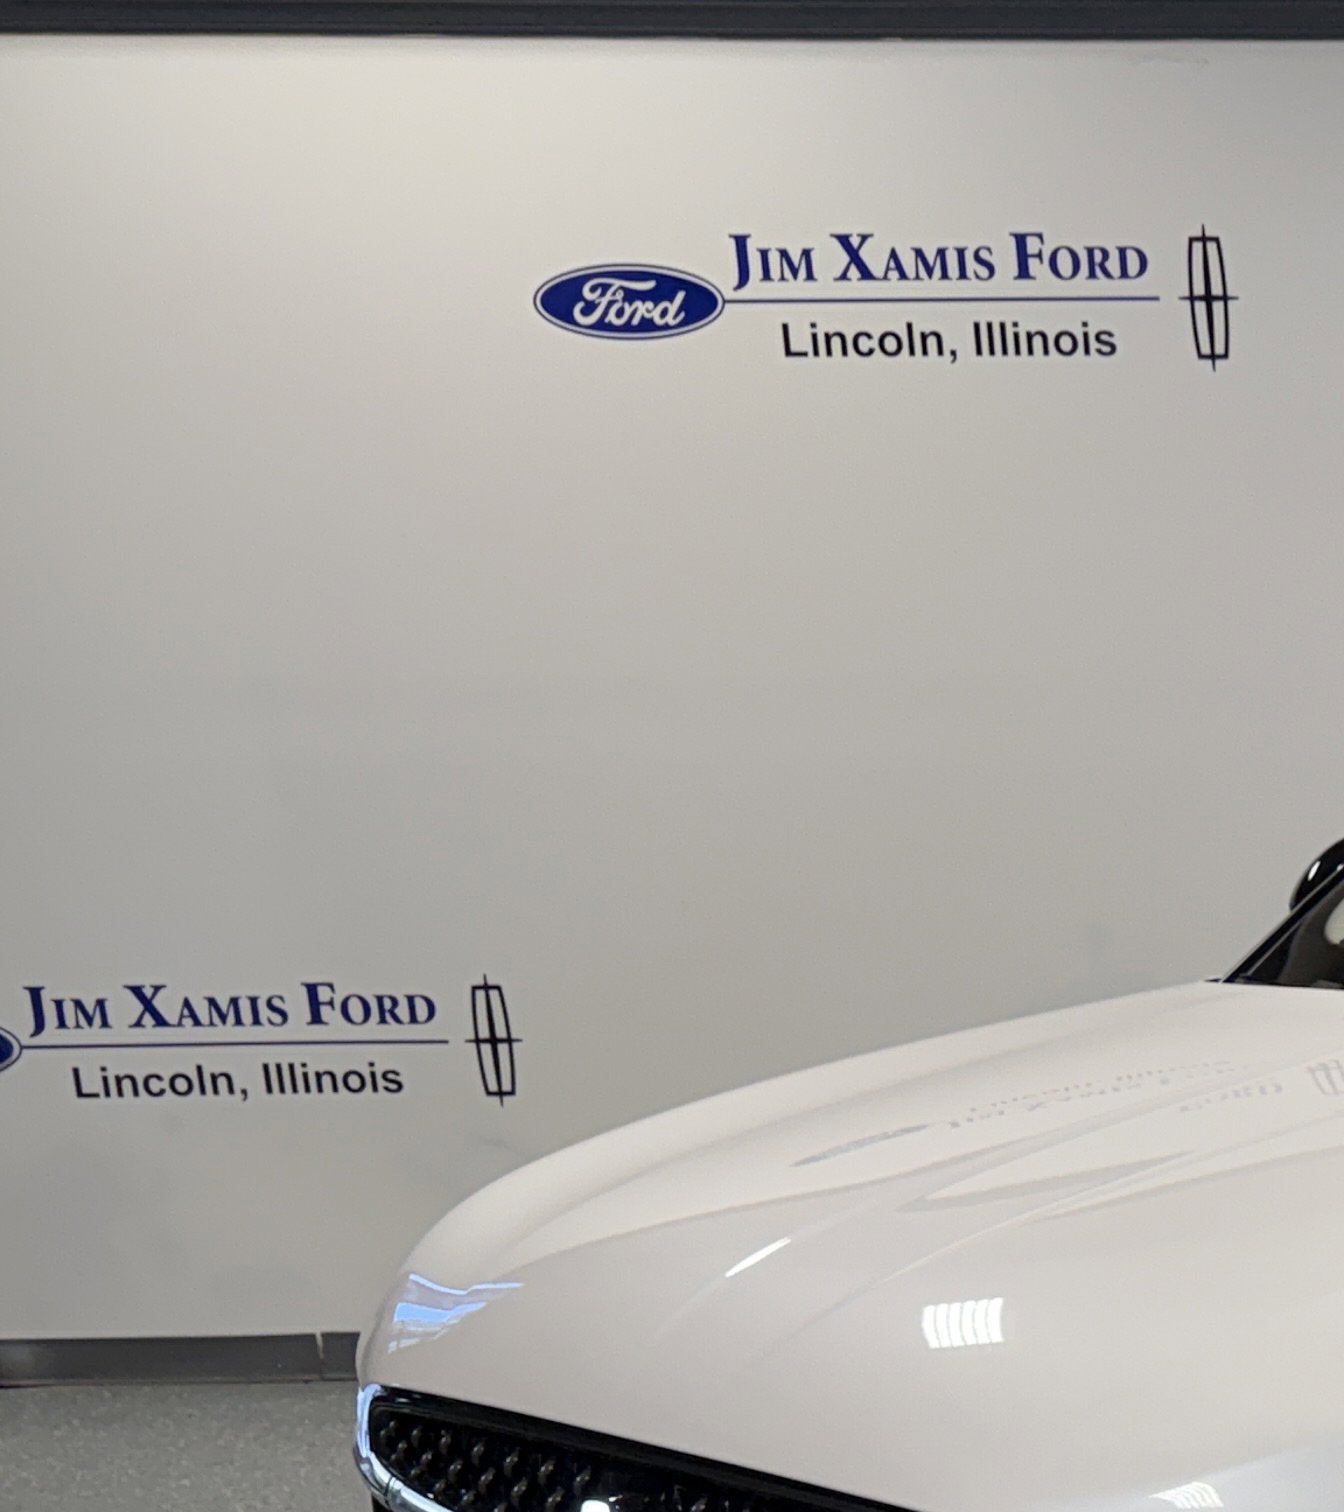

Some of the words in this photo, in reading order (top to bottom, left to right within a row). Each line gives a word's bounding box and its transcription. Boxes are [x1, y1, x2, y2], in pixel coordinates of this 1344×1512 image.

[729, 233, 817, 291] JIM
[829, 233, 996, 282] XAMIS
[1009, 232, 1148, 281] FORD
[572, 277, 686, 328] Ford
[782, 321, 958, 364] Lincoln,
[973, 321, 1117, 357] Illinois
[23, 985, 112, 1038] JIM
[123, 984, 289, 1029] XAMIS
[301, 982, 436, 1026] FORD
[72, 1064, 248, 1102] Lincoln,
[262, 1061, 404, 1095] Illinois
